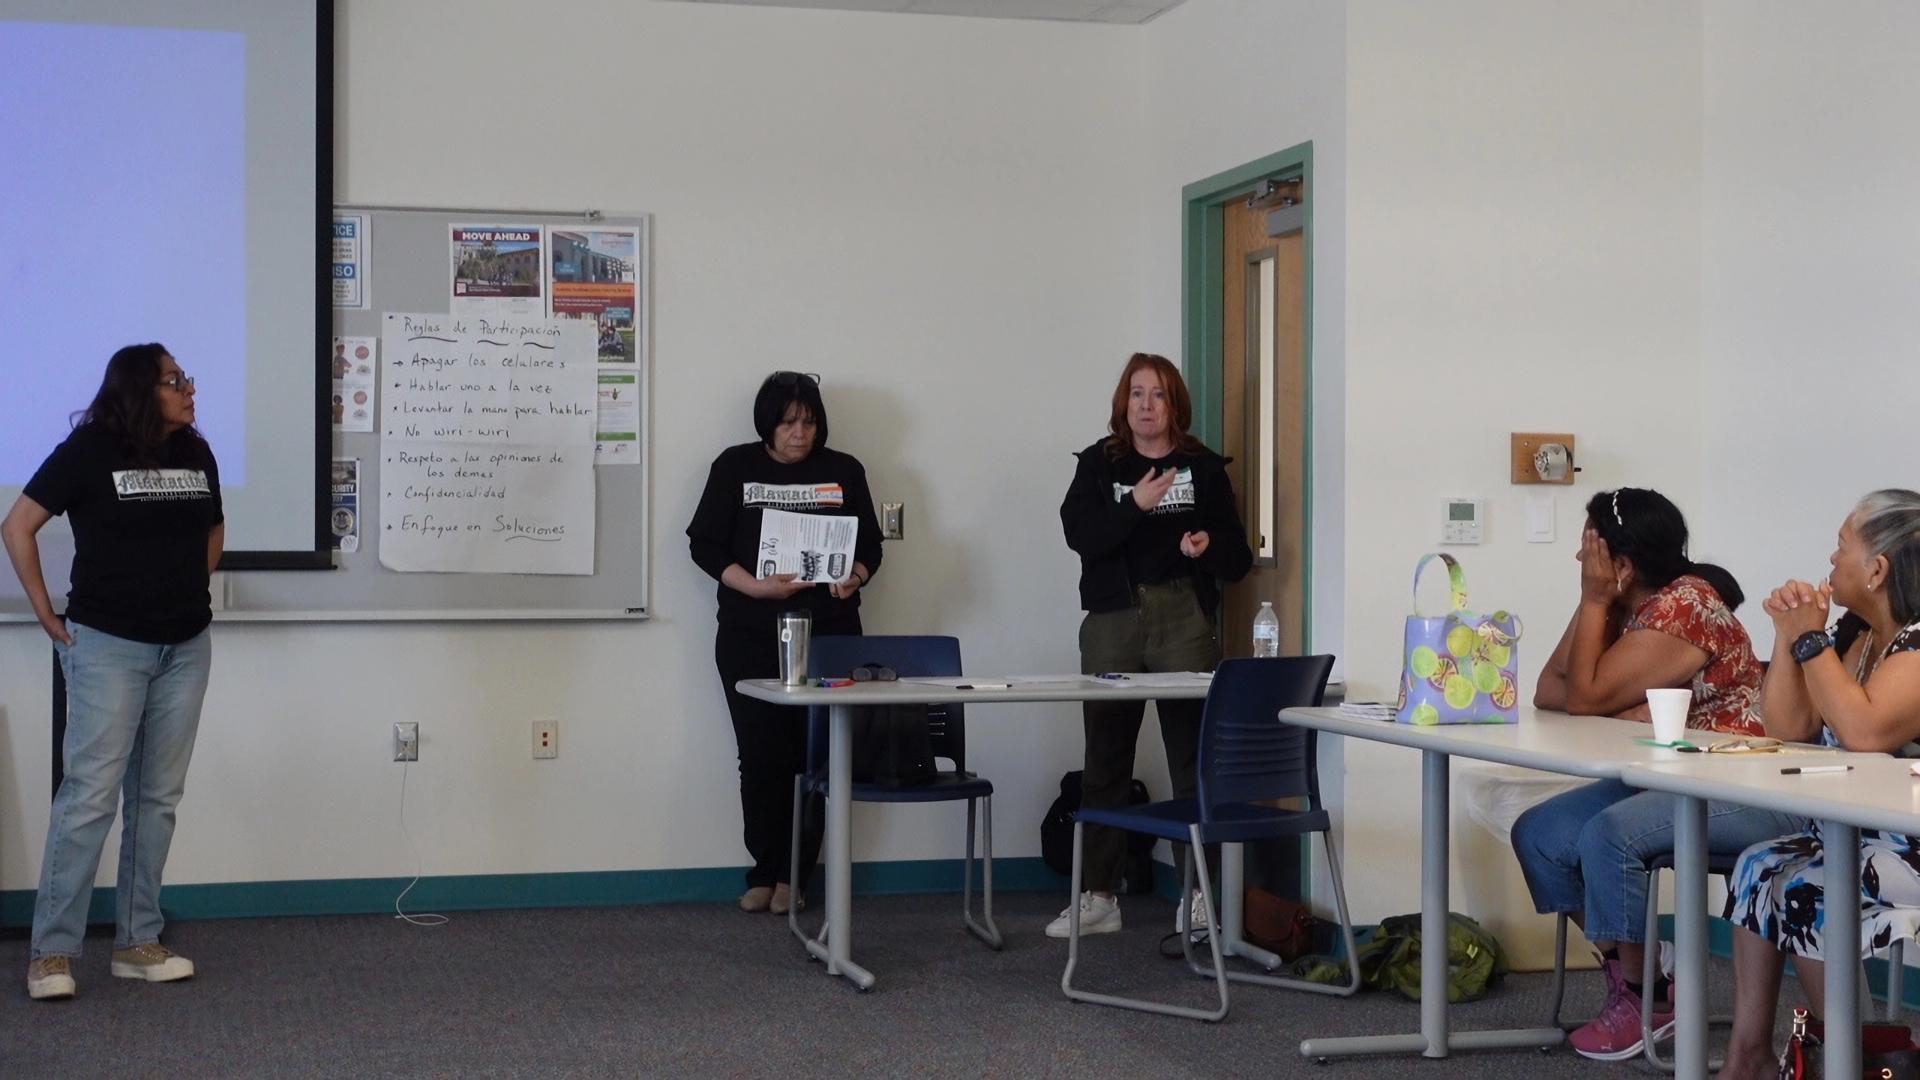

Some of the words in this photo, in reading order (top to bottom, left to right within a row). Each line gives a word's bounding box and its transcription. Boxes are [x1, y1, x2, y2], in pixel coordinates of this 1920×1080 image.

[462, 232, 492, 240] MOVE
[494, 232, 531, 241] AHEAD
[404, 316, 440, 337] Reglas
[453, 320, 468, 334] de
[411, 353, 458, 371] Apagar
[469, 353, 486, 366] los
[502, 353, 565, 369] celulares
[409, 379, 451, 392] Hablar
[488, 384, 497, 392] a
[509, 379, 520, 392] la
[530, 385, 553, 394] vez
[403, 401, 454, 414] Levantar
[464, 401, 473, 414] la
[482, 406, 508, 414] mano
[515, 406, 540, 419] para
[550, 401, 593, 415] hablar
[405, 426, 421, 437] No
[400, 451, 443, 467] Respeto
[465, 451, 480, 463] las
[490, 454, 542, 466] opiniones
[549, 451, 564, 463] de
[427, 466, 445, 478] los
[405, 486, 506, 503] Confidencialidad
[401, 515, 459, 539] Enfoque
[493, 515, 565, 535] Soluciones
